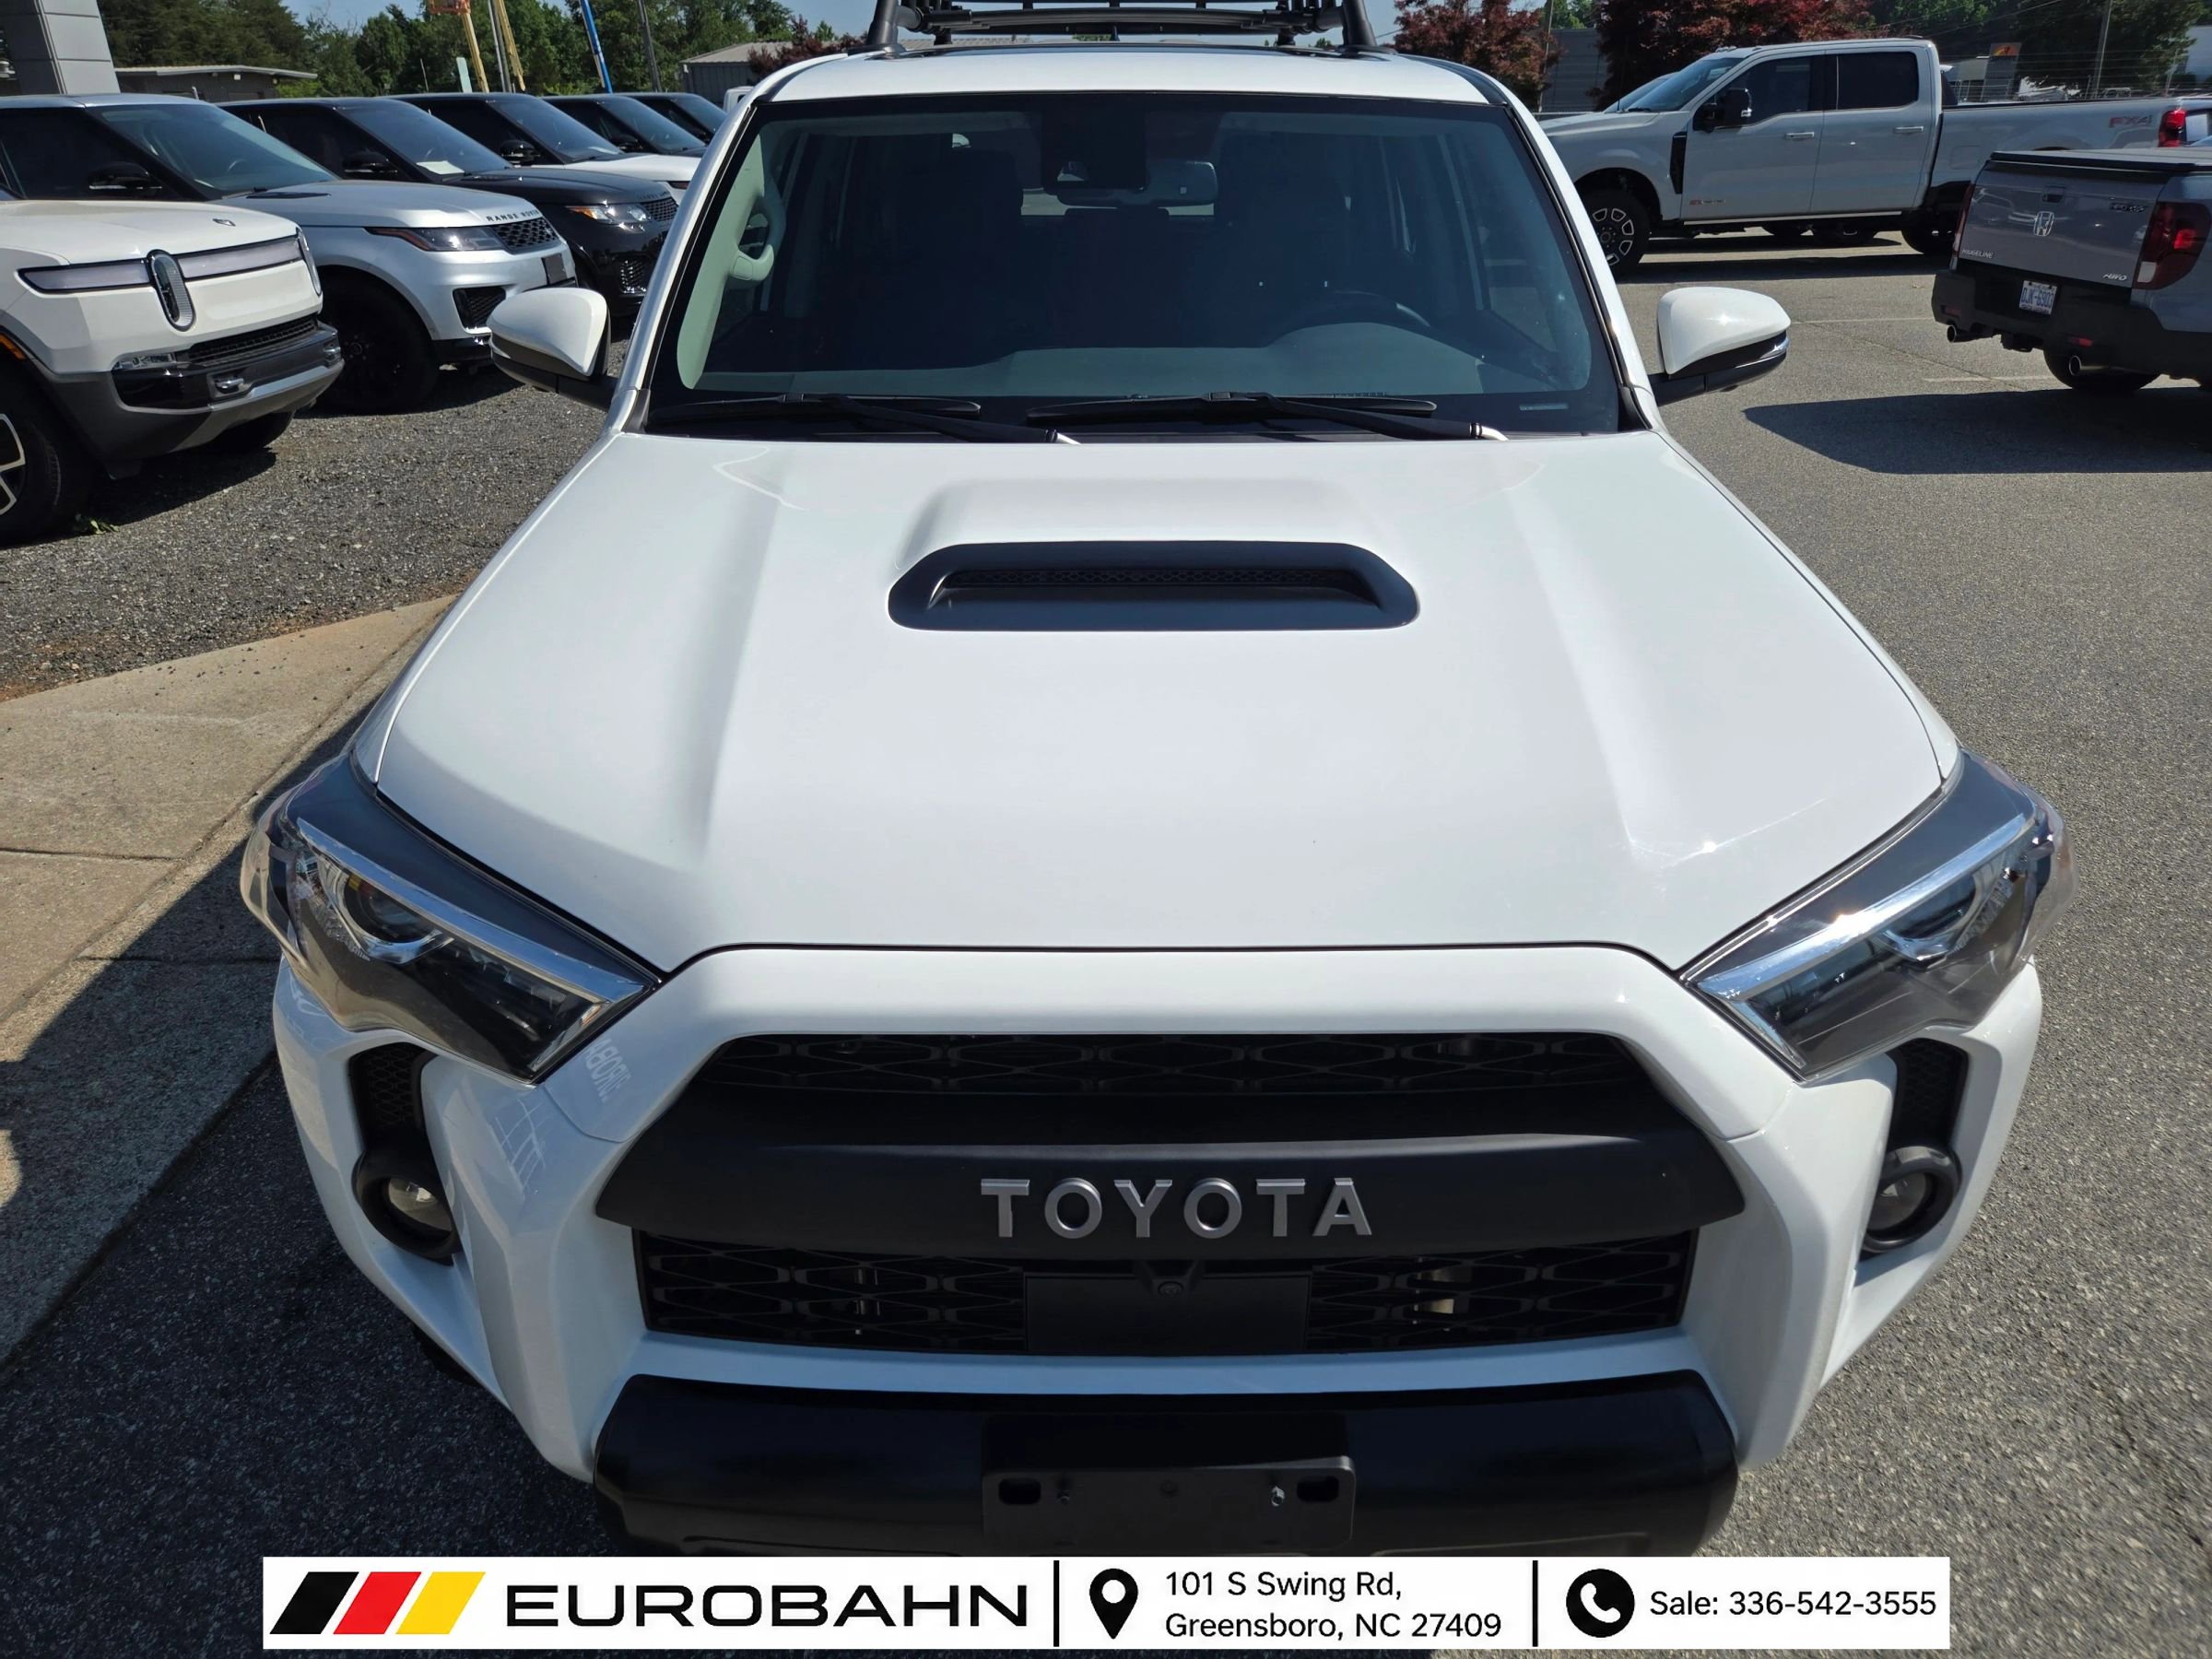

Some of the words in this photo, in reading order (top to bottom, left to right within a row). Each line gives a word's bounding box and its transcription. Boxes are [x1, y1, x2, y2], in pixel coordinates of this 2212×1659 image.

[486, 213, 519, 222] RANGE
[2102, 273, 2128, 281] AWD
[980, 1177, 1373, 1240] TOYOTA
